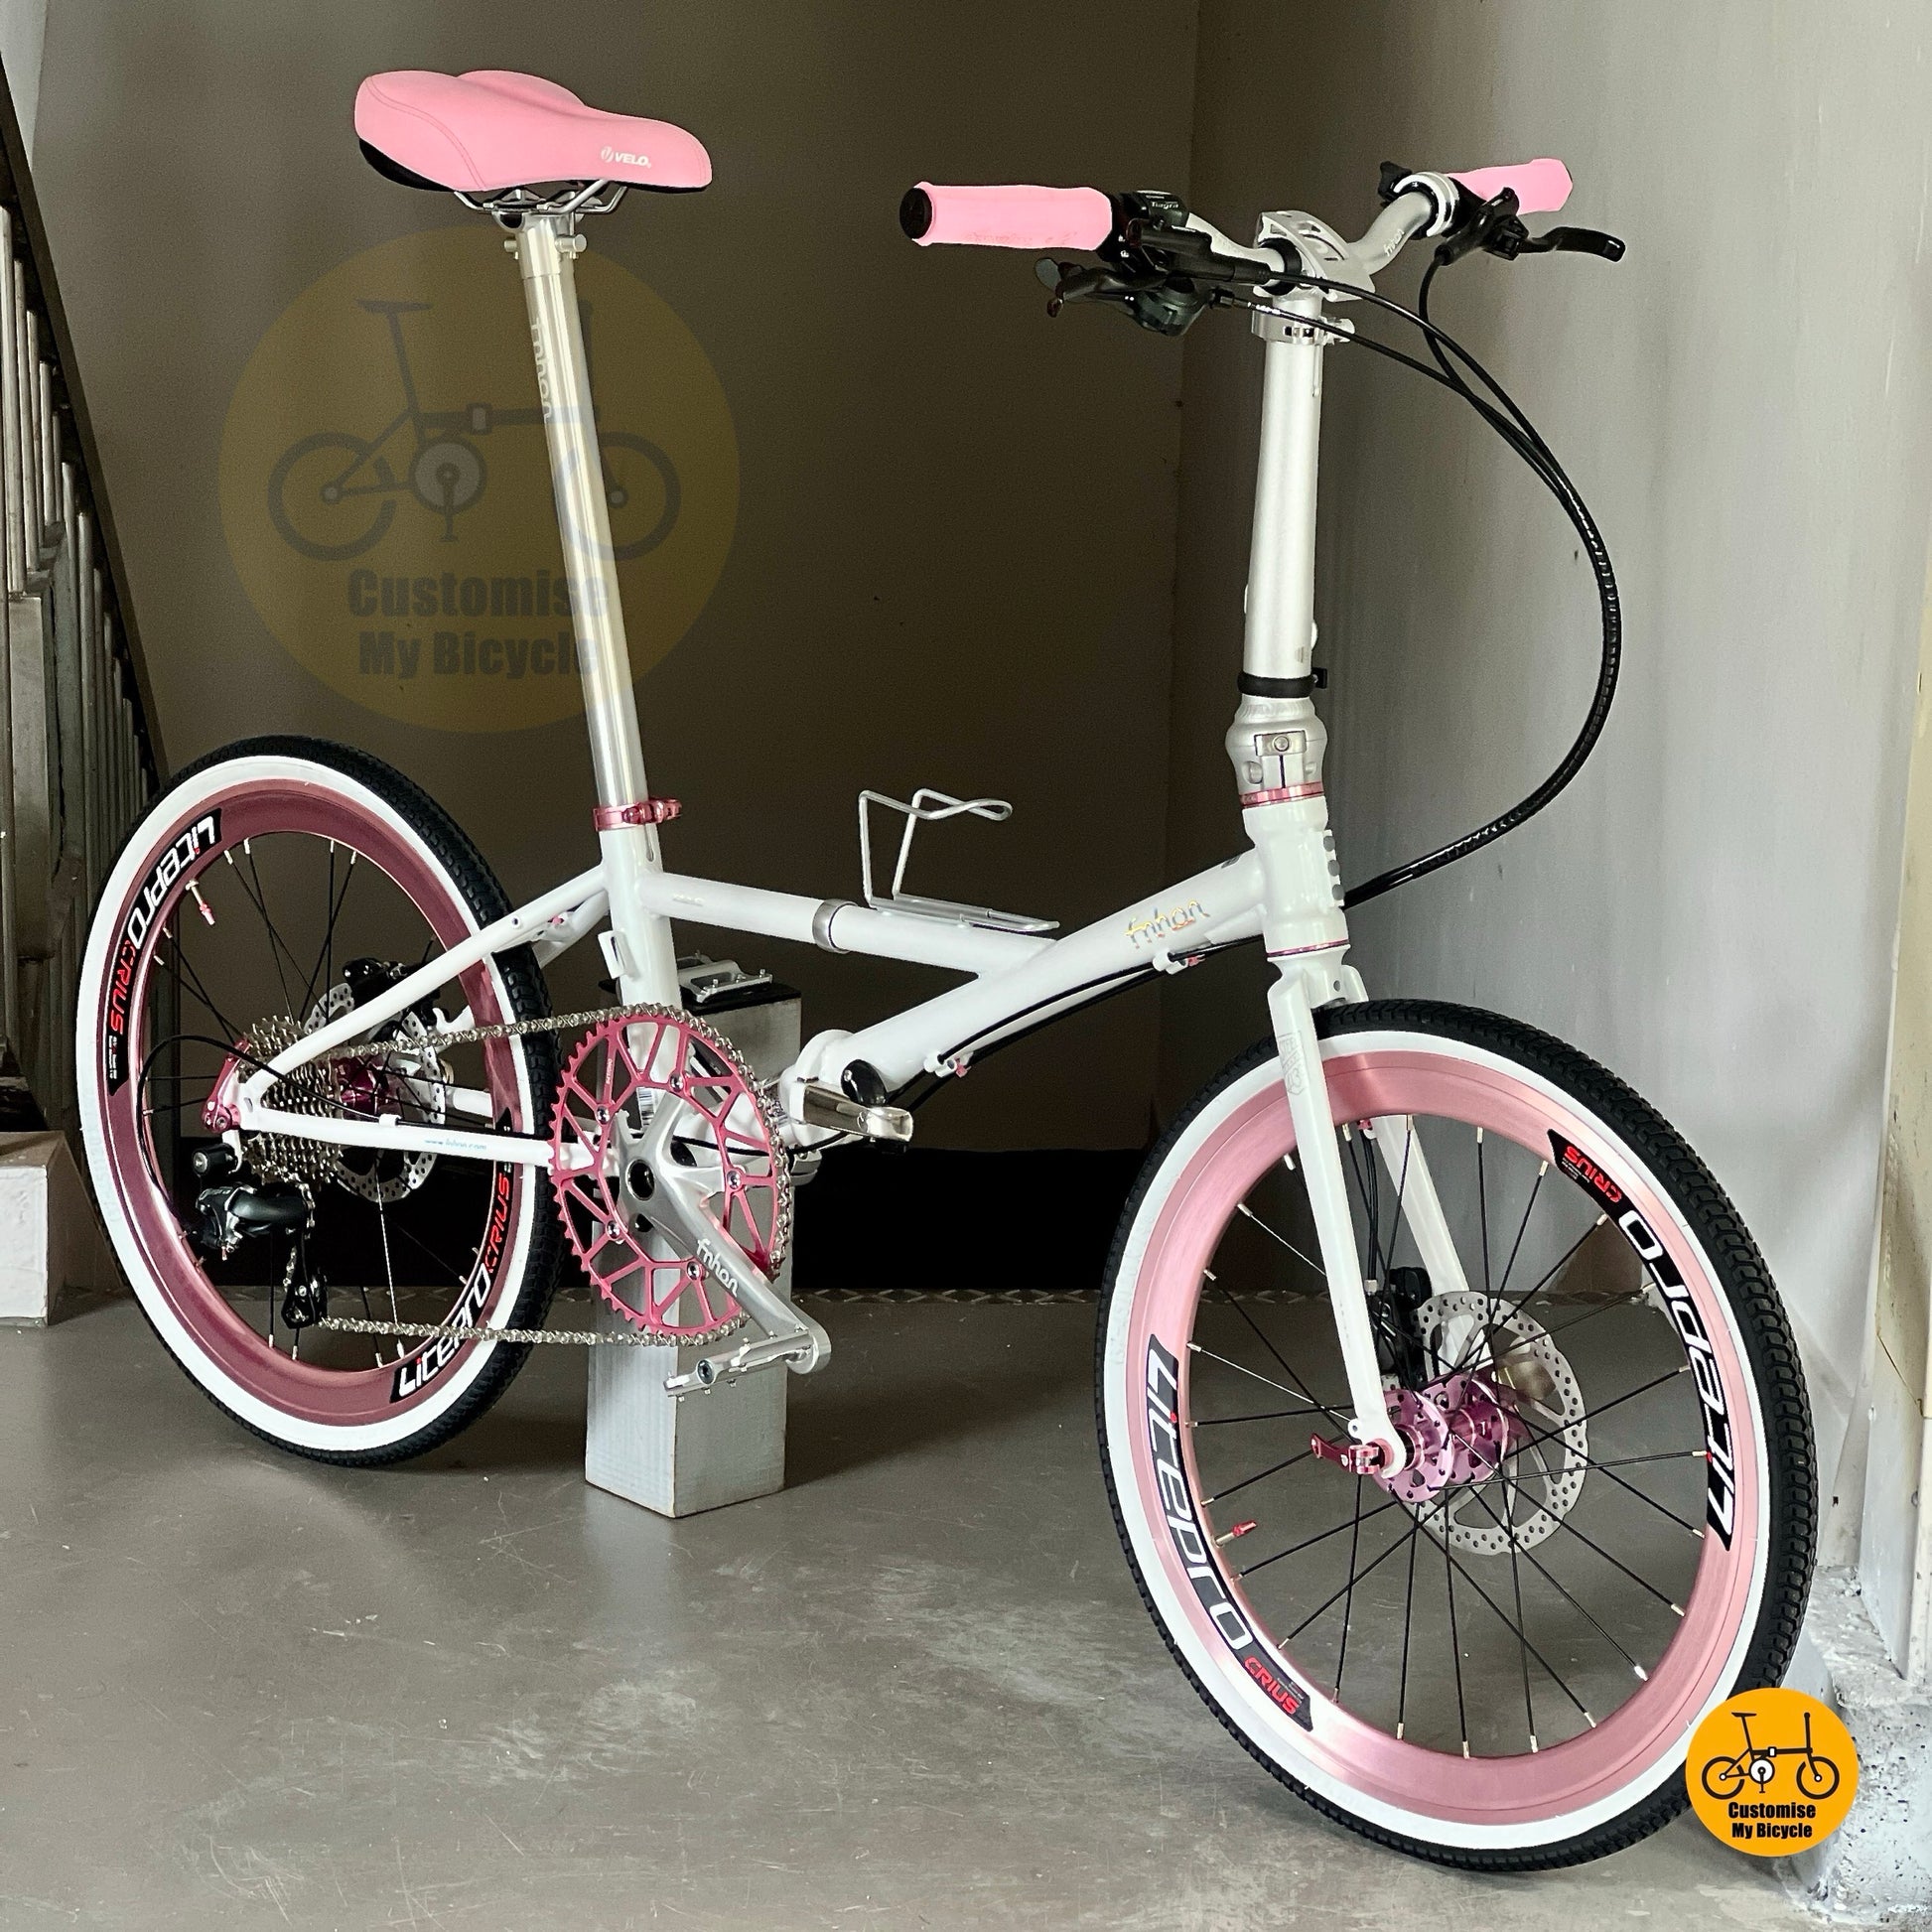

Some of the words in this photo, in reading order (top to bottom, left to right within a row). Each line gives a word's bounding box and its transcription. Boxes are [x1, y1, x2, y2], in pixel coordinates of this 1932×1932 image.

[615, 152, 649, 167] VELO
[109, 939, 136, 1035] CRIUS
[1564, 1146, 1622, 1203] CRIUS
[483, 1173, 511, 1275] CRIUS
[1244, 1656, 1301, 1715] CRIUS
